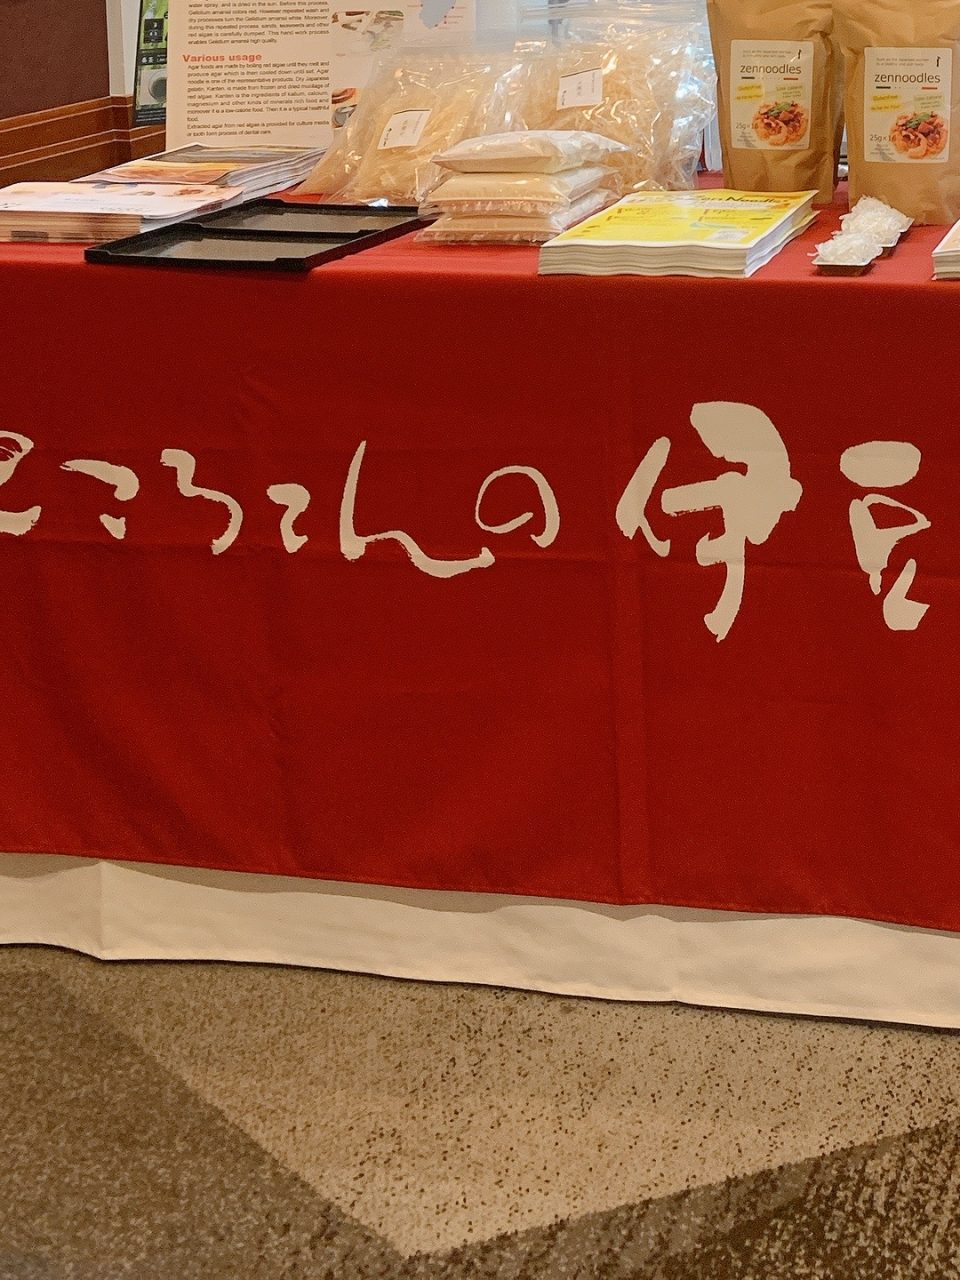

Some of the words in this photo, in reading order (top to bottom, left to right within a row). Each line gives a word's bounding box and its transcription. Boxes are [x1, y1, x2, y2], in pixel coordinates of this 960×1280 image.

[182, 54, 225, 63] Various
[228, 54, 262, 63] usage
[740, 64, 802, 74] zennoodles
[874, 73, 941, 83] zennoodles
